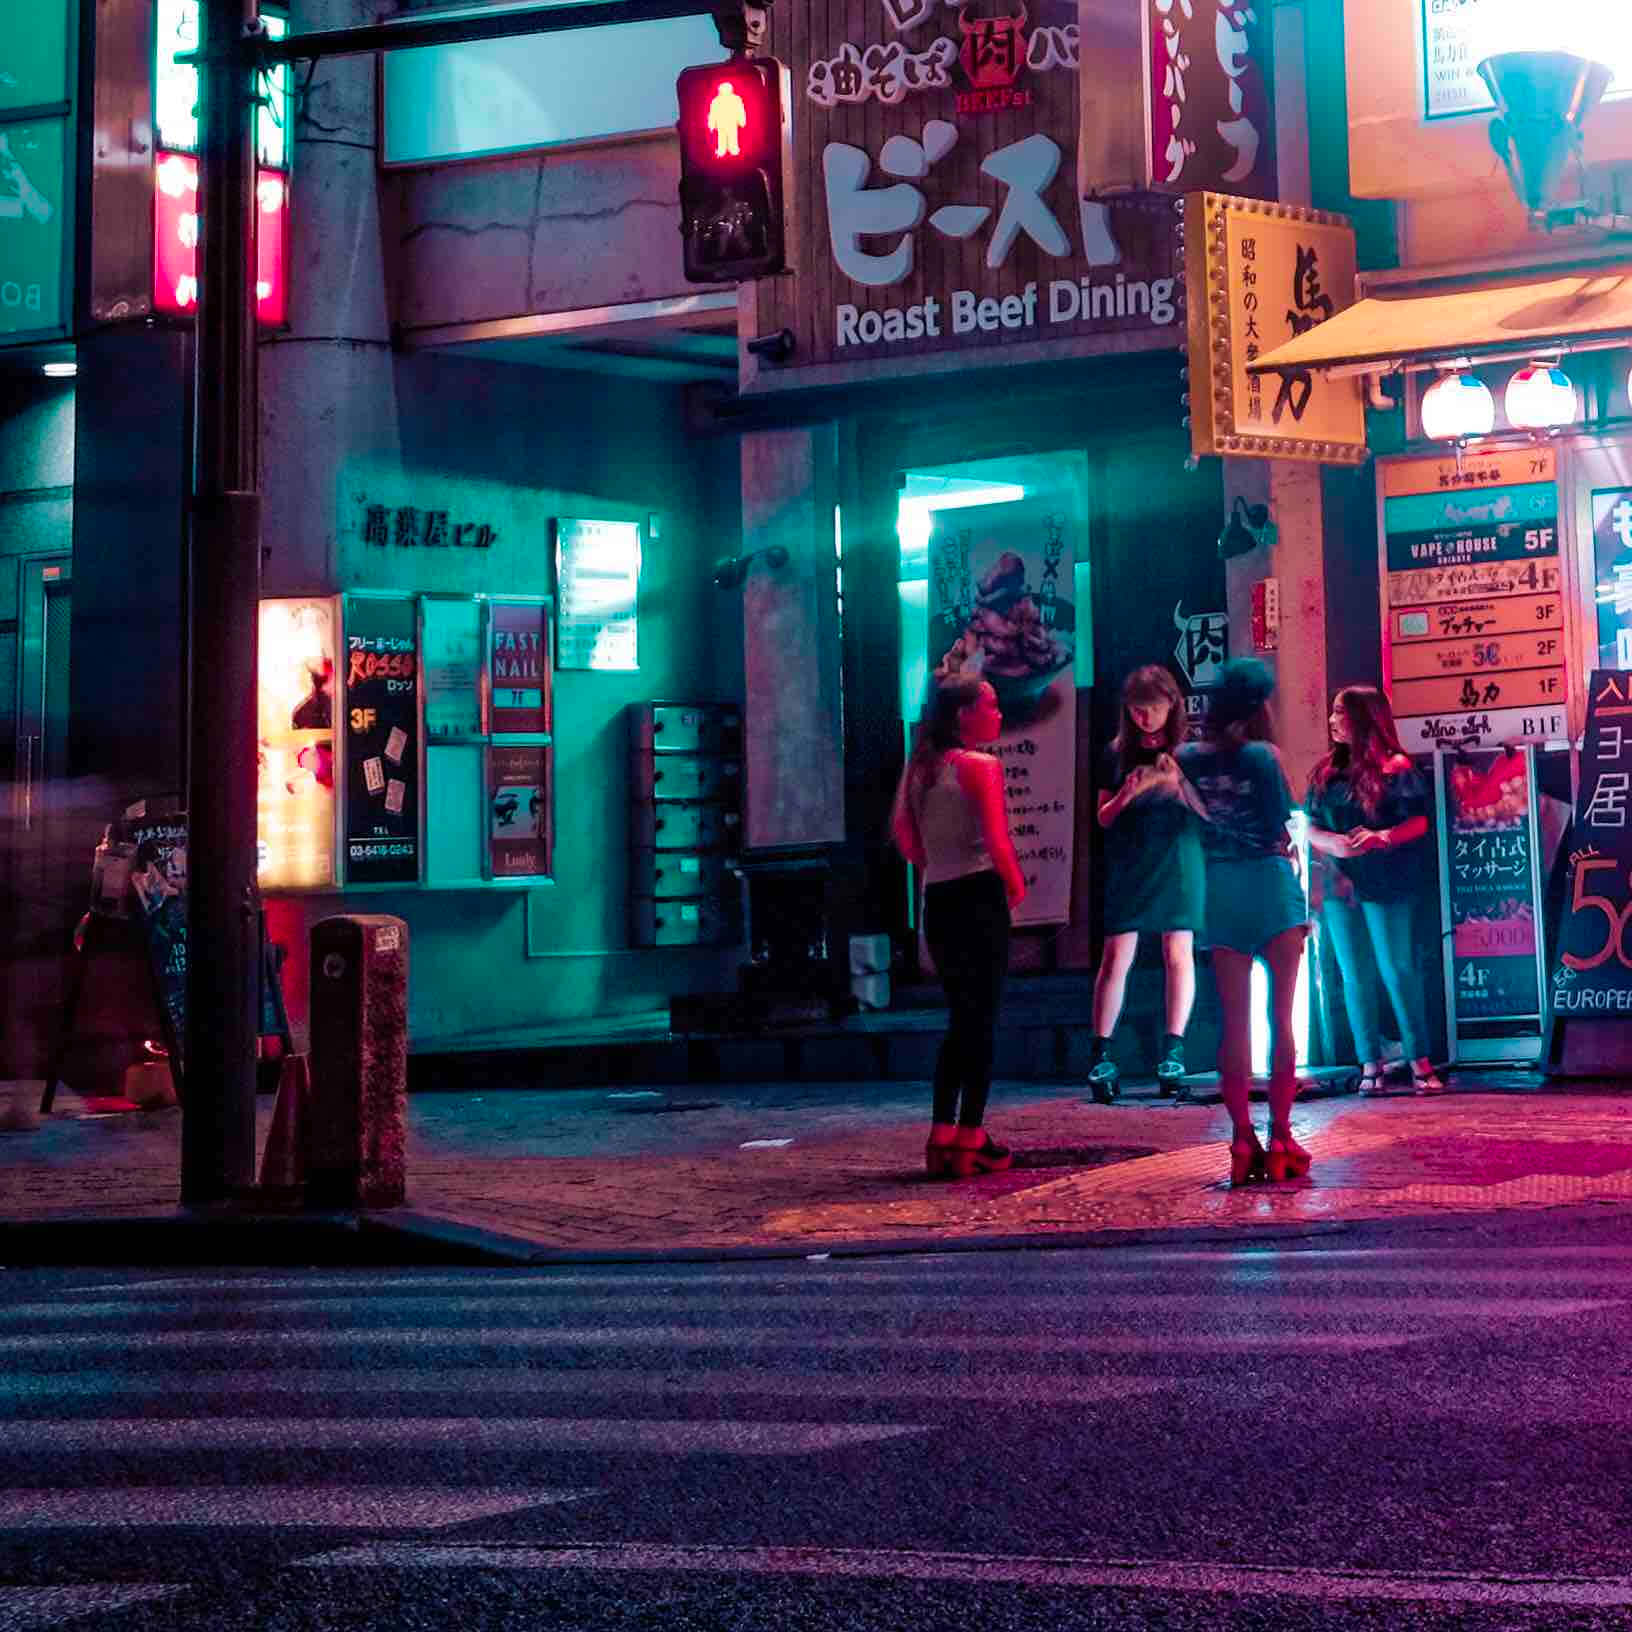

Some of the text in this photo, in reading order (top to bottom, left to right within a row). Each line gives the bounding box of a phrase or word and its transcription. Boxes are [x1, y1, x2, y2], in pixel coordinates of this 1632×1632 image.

[807, 36, 960, 108] 油そば
[836, 274, 1175, 347] Roast Beef Dining
[1529, 458, 1549, 475] 7F
[1411, 536, 1498, 559] VAPE HOUSE
[1524, 528, 1553, 552] 5F
[1536, 604, 1556, 621] 3F
[495, 632, 541, 652] FAST
[1537, 639, 1556, 657] 2F
[495, 659, 540, 678] NAIL
[1539, 677, 1558, 695] 1F
[350, 708, 377, 730] 3F
[1522, 716, 1562, 737] B1F
[1455, 835, 1527, 859] タイ古式
[1455, 860, 1527, 879] マッサージ
[1459, 960, 1490, 987] 4F
